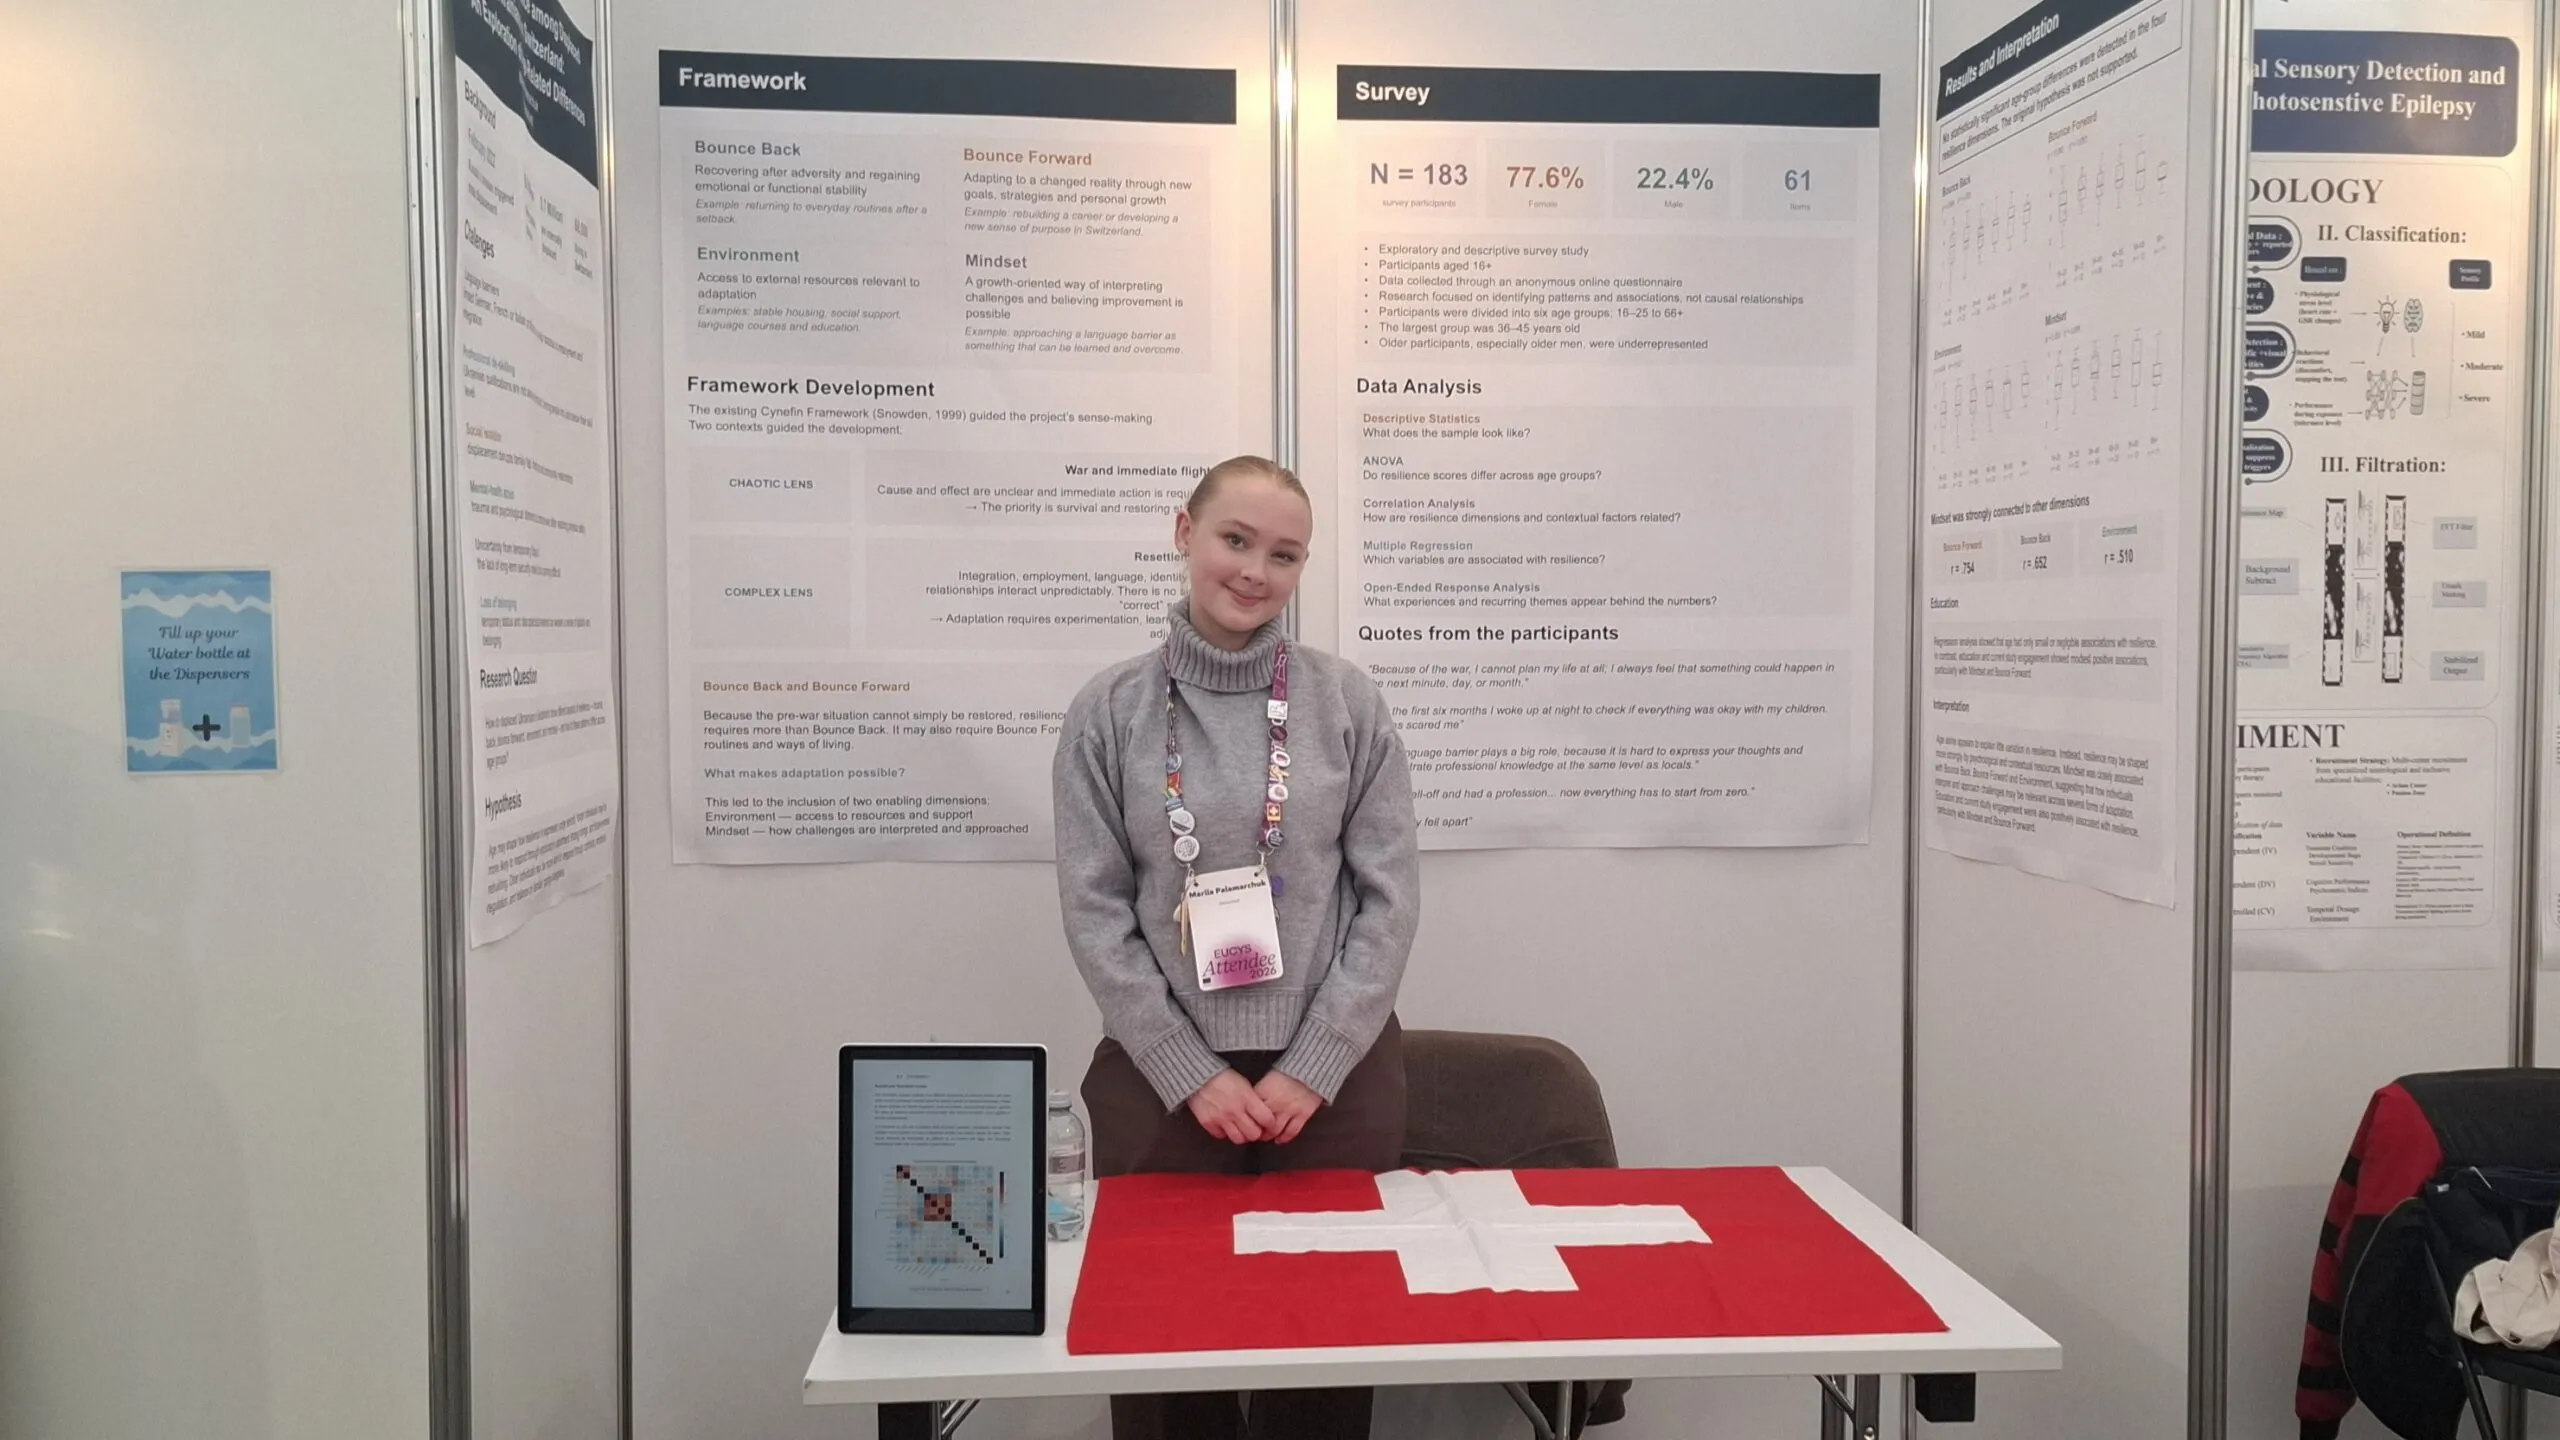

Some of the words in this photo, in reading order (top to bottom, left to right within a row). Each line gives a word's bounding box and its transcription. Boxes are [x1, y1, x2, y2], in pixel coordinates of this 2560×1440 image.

[1945, 65, 1977, 97] Results
[1978, 49, 1996, 77] and
[1996, 13, 2060, 66] Interpretation
[678, 67, 807, 92] Framework
[1980, 97, 2010, 124] significant
[2042, 61, 2078, 89] differences
[2079, 52, 2095, 68] were
[2096, 31, 2128, 59] detected
[2129, 28, 2136, 41] in
[2137, 21, 2150, 36] the
[2274, 57, 2361, 85] Sensory
[2366, 59, 2463, 84] Detection
[2468, 65, 2506, 85] and
[1355, 80, 1431, 107] Survey
[2036, 81, 2071, 112] hypothesis
[2072, 76, 2086, 91] was
[2087, 67, 2099, 83] not
[464, 79, 496, 129] Background
[553, 80, 586, 127] Differences
[2253, 90, 2385, 113] hotosenstive
[2390, 92, 2477, 121] Epilepsy
[694, 140, 756, 155] Bounce
[761, 142, 801, 157] Back
[963, 148, 1024, 163] Bounce
[1028, 149, 1092, 166] Forward
[695, 163, 759, 179] Recovering
[763, 166, 788, 177] after
[791, 168, 841, 182] adversity
[844, 169, 866, 180] and
[869, 170, 921, 185] regaining
[1371, 162, 1389, 185] N
[1398, 169, 1414, 180] =
[1424, 163, 1468, 186] 183
[1506, 166, 1584, 189] 77.6%
[1636, 168, 1714, 191] 22.4%
[1784, 170, 1811, 192] 61
[2318, 224, 2339, 242] II.
[2345, 224, 2467, 243] Classification:
[697, 246, 800, 263] Environment
[1379, 243, 1439, 257] Exploratory
[1441, 245, 1461, 255] and
[1464, 245, 1521, 258] descriptive
[1523, 248, 1559, 259] survey
[1561, 246, 1590, 259] study
[965, 253, 1028, 269] Mindset
[2466, 330, 2486, 339] Mild
[2465, 361, 2504, 371] Moderate
[687, 375, 799, 396] Framework
[805, 378, 935, 401] Development
[1356, 377, 1399, 394] Data
[1402, 378, 1483, 399] Analysis
[2463, 393, 2491, 403] Severe
[688, 404, 711, 415] The
[713, 405, 757, 419] existing
[760, 406, 804, 420] Cynefin
[807, 407, 870, 418] Framework
[872, 408, 932, 421] (Snowden,
[935, 409, 967, 422] 1999)
[969, 411, 1007, 424] guided
[1009, 411, 1027, 421] the
[1077, 413, 1153, 426] sense-making
[1363, 413, 1426, 425] Descriptive
[1429, 413, 1481, 424] Statistics
[1363, 455, 1404, 466] ANOVA
[2321, 456, 2350, 473] III.
[2355, 456, 2446, 473] Filtration:
[729, 478, 781, 489] CHAOTIC
[783, 479, 814, 489] LENS
[1363, 498, 1425, 509] Correlation
[1428, 498, 1476, 511] Analysis
[1952, 513, 1964, 523] was
[1965, 508, 1992, 523] strongly
[1993, 503, 2024, 518] connected
[2032, 501, 2049, 514] other
[2049, 494, 2090, 510] dimensions
[1363, 540, 1407, 552] Multiple
[1410, 540, 1473, 553] Regression
[2116, 548, 2134, 564] .510
[2245, 564, 2291, 575] Background
[1363, 582, 1432, 595] Open-Ended
[1435, 582, 1490, 595] Response
[1492, 582, 1541, 595] Analysis
[2245, 577, 2277, 585] Subtract
[724, 587, 781, 598] COMPLEX
[783, 587, 814, 598] LENS
[1930, 597, 1959, 609] Education
[158, 624, 182, 639] Fill
[184, 629, 202, 644] up
[206, 629, 239, 644] your
[1358, 624, 1423, 643] Quotes
[1428, 625, 1471, 641] from
[1476, 625, 1506, 641] the
[1511, 624, 1620, 646] participants
[148, 646, 193, 660] Water
[195, 645, 234, 660] bottle
[236, 647, 251, 659] at
[149, 666, 171, 681] the
[173, 666, 251, 685] Dispensers
[480, 666, 512, 688] Research
[703, 680, 750, 692] Bounce
[753, 681, 783, 692] Back
[786, 681, 809, 692] and
[812, 681, 858, 692] Bounce
[861, 681, 911, 692] Forward
[1933, 698, 1970, 714] Interpretation
[2236, 724, 2346, 749] IMENT
[704, 767, 736, 779] What
[739, 768, 779, 779] makes
[781, 767, 845, 780] adaptation
[848, 767, 906, 780] possible?
[1559, 789, 1582, 798] now
[1584, 787, 1638, 800] everything
[1639, 787, 1659, 798] has
[1661, 787, 1672, 797] to
[1674, 787, 1698, 797] start
[1699, 787, 1724, 797] from
[485, 790, 522, 821] Hypothesis
[1213, 943, 1252, 959] EUCYS
[1202, 951, 1277, 977] Attendee
[1250, 966, 1277, 979] 2026
